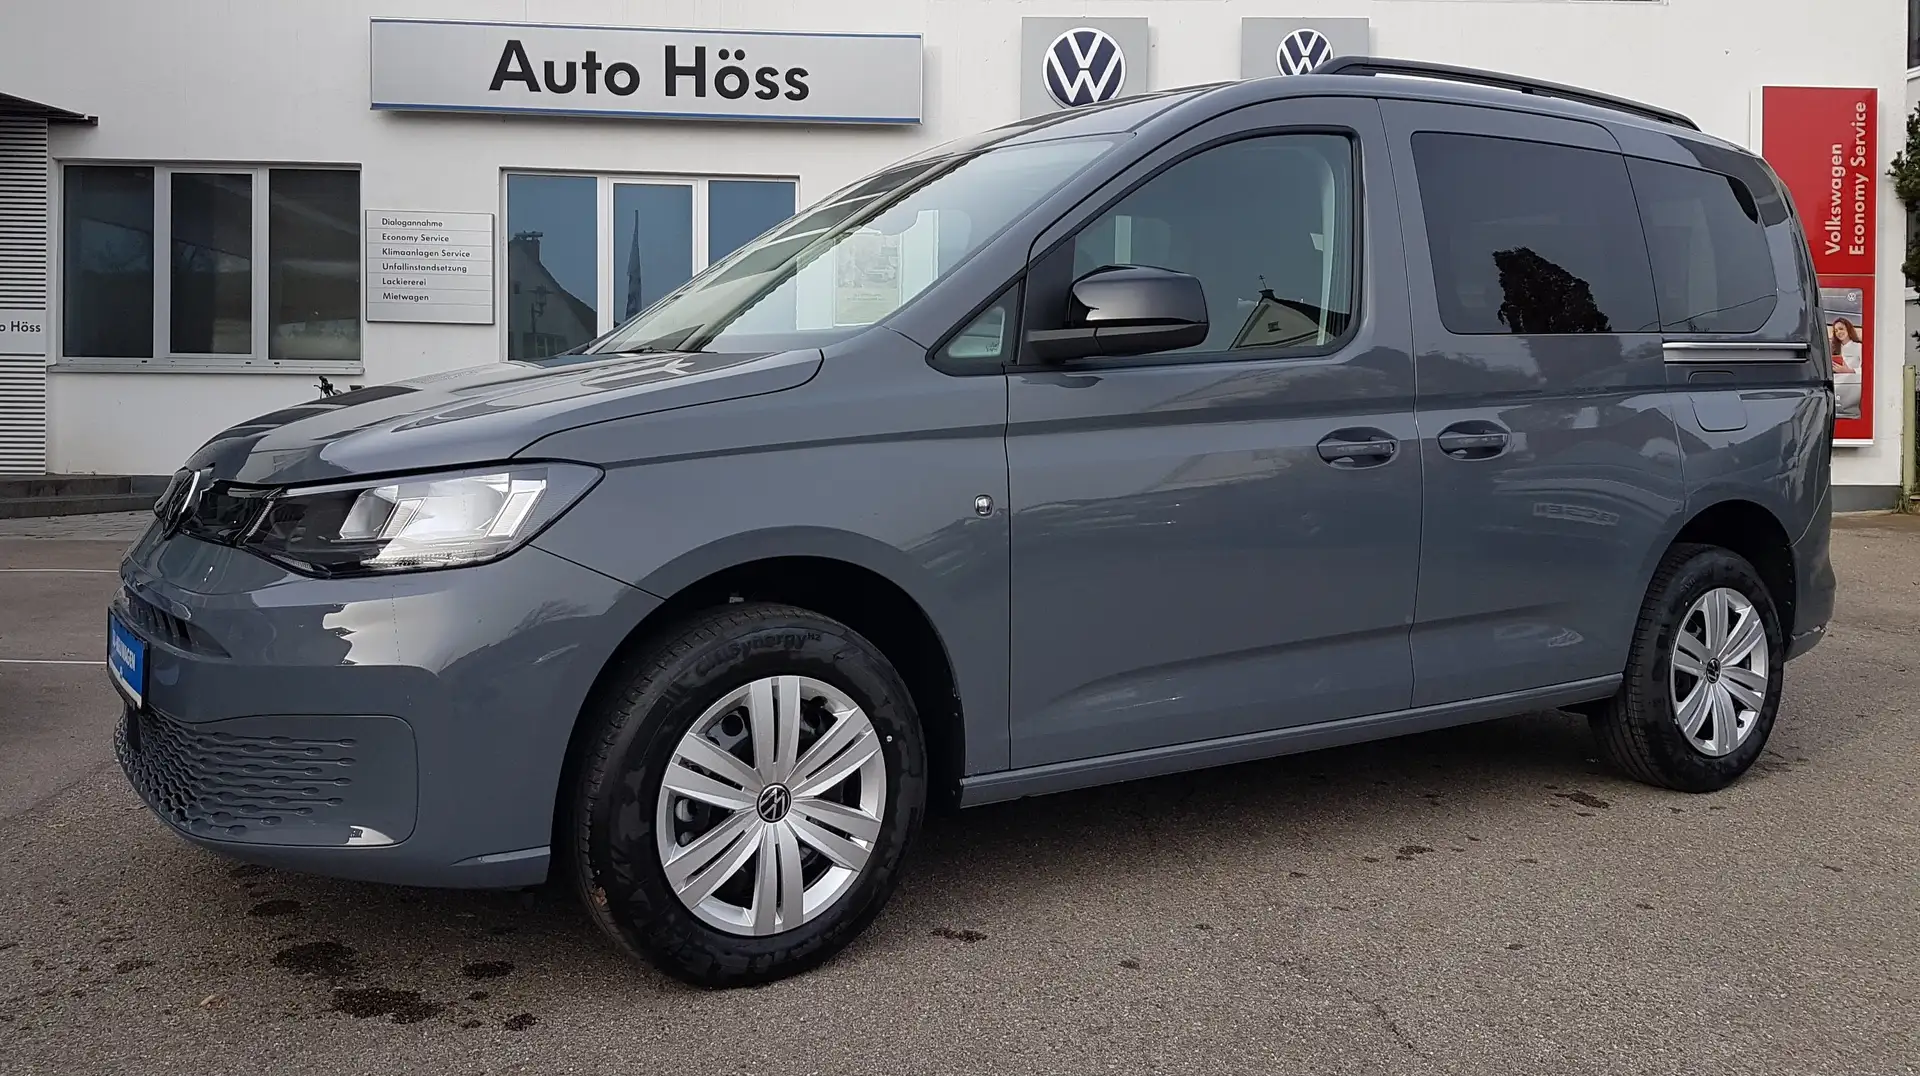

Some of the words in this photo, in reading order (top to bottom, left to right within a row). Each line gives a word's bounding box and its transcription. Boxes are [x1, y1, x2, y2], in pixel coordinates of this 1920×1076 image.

[488, 39, 640, 97] Auto
[664, 44, 810, 101] Höss
[1850, 101, 1866, 167] Service
[1825, 143, 1845, 256] Volkswagen
[1849, 172, 1869, 255] Economy
[381, 217, 443, 228] Dialogannahme
[382, 233, 419, 243] Economy
[420, 234, 450, 243] Service
[382, 248, 440, 259] Klimaanlagen
[441, 249, 471, 258] Service
[382, 263, 468, 274] Unfallinstandsetzung
[382, 277, 427, 287] Lackiererei
[382, 292, 430, 303] Mietwagen
[11, 320, 41, 333] Höss
